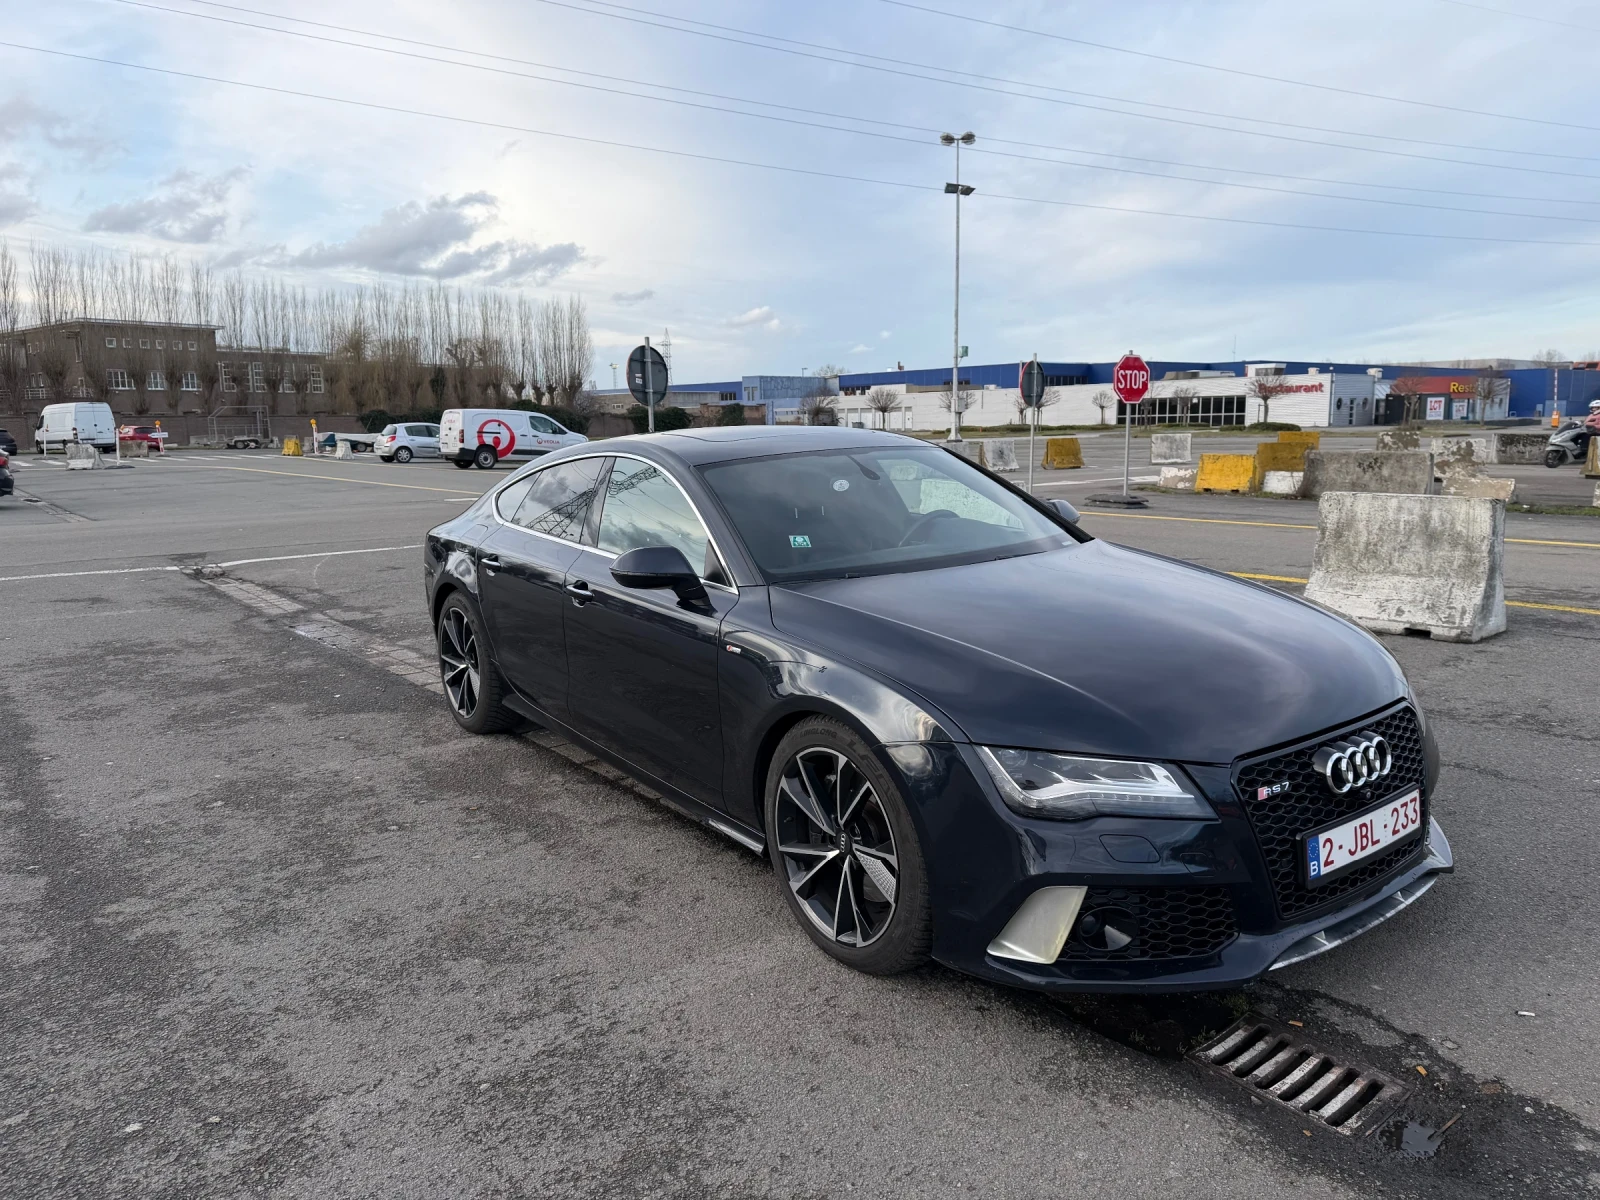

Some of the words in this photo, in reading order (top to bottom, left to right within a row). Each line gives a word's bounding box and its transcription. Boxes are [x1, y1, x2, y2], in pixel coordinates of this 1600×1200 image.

[1117, 369, 1147, 389] STOP
[1263, 781, 1290, 799] RS7
[1322, 796, 1418, 868] 2-JBL-233
[1310, 861, 1319, 876] B
